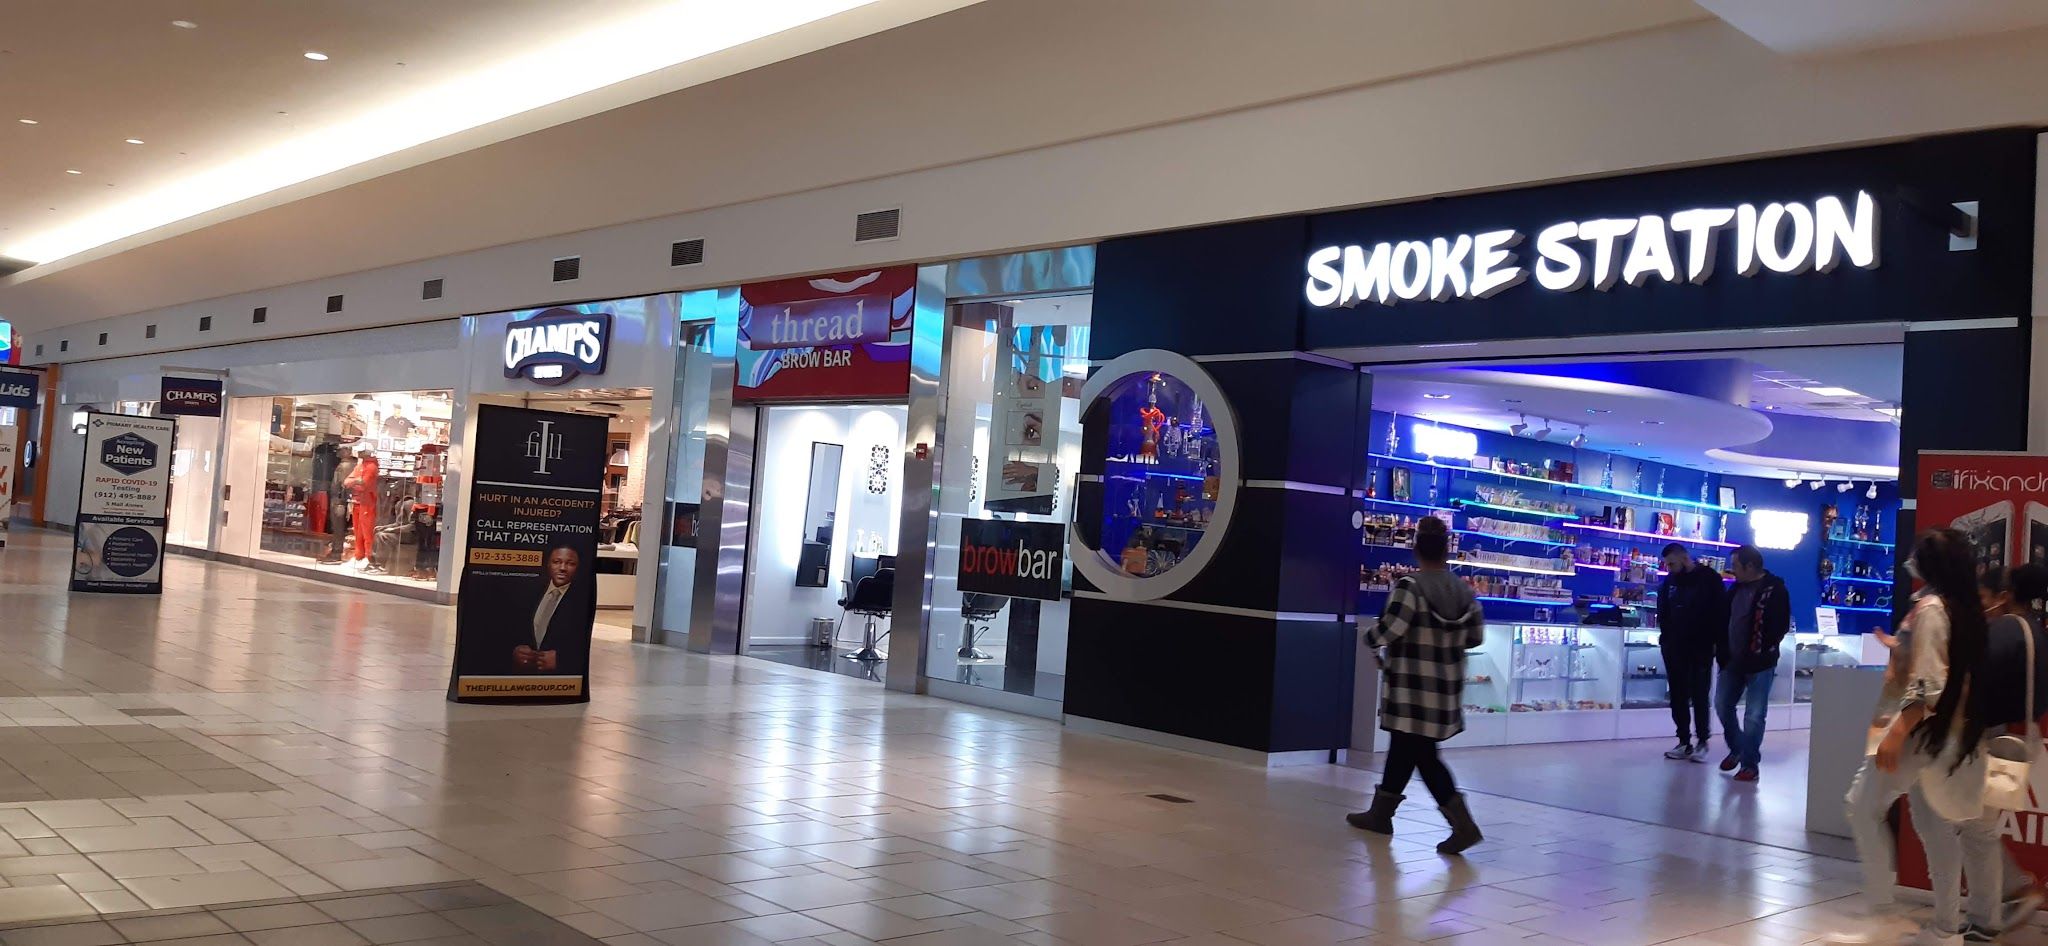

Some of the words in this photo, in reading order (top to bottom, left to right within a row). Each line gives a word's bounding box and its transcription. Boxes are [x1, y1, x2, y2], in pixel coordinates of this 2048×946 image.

[1306, 229, 1524, 308] SMOKE
[1535, 190, 1877, 293] STATION
[771, 299, 864, 345] thread
[505, 321, 601, 369] CHAMPS
[781, 350, 820, 369] BROW
[824, 349, 852, 368] BAR
[0, 383, 30, 397] Lids
[166, 390, 218, 404] CHAMPS
[116, 445, 144, 455] New
[105, 454, 153, 466] Patients
[95, 476, 120, 484] RAPID
[121, 478, 158, 486] COVID-19
[94, 491, 117, 499] (912)
[112, 485, 141, 493] Testing
[479, 493, 508, 503] HURT
[523, 497, 539, 505] AN
[541, 498, 595, 509] ACCIDENT?
[513, 507, 562, 518] INJURED?
[125, 517, 155, 525] Services
[476, 519, 504, 529] CALL
[506, 521, 593, 534] REPRESENTATION
[476, 530, 511, 542] THAT
[513, 533, 549, 545] PAYS!
[474, 551, 540, 563] 912-335-3888
[465, 684, 576, 692] THEIFILLLAWGROUP.COM
